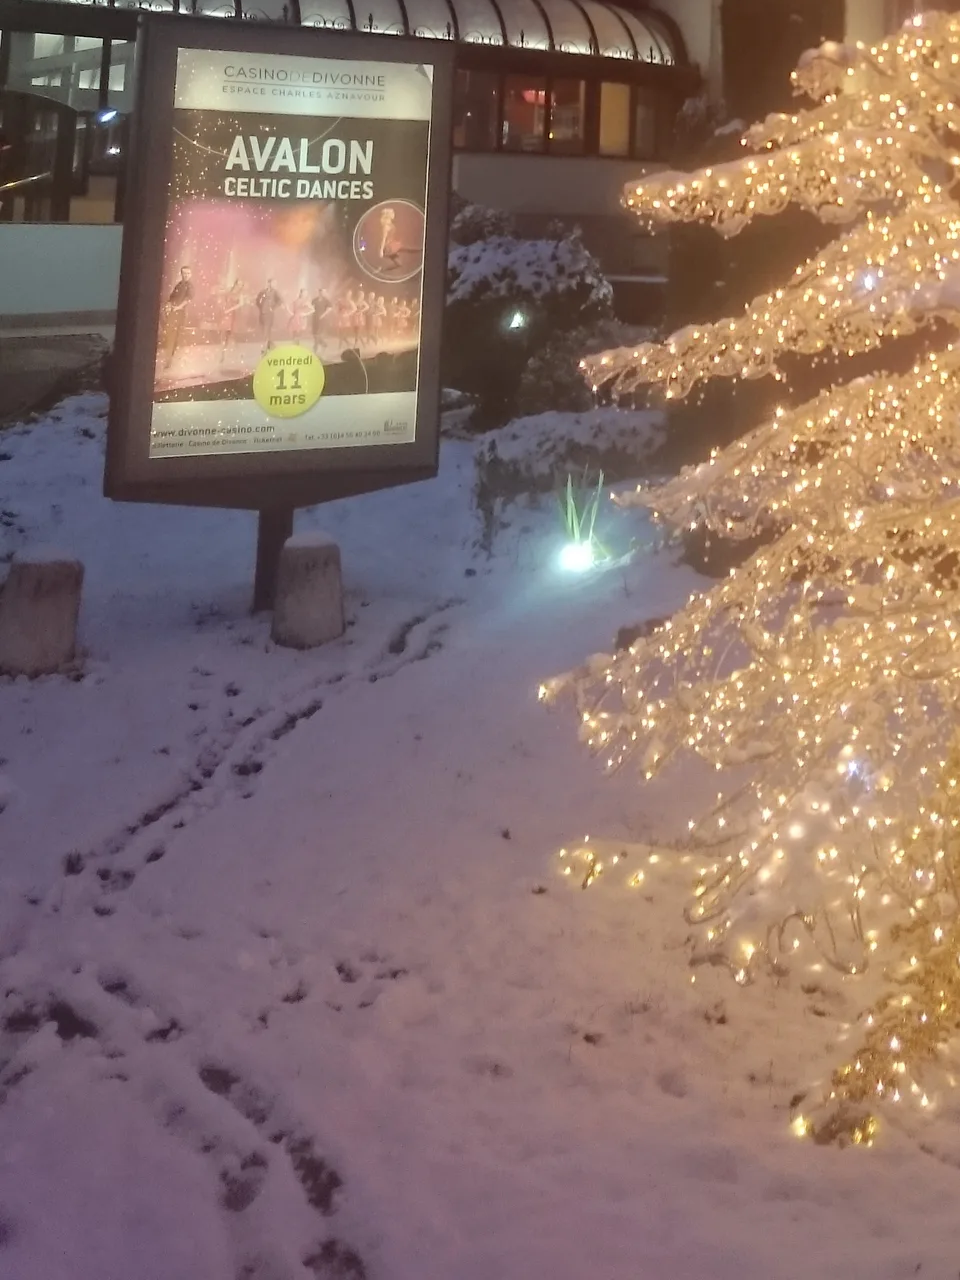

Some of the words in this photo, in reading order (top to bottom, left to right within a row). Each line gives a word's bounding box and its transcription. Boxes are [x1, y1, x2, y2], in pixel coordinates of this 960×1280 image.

[222, 85, 267, 96] ESPACE
[271, 88, 321, 98] CHARLES
[326, 91, 386, 102] AZNAVOUR
[225, 135, 374, 175] AVALON
[224, 177, 291, 198] CELTIC
[296, 179, 374, 199] DANCES
[267, 355, 313, 367] vendredi
[276, 369, 302, 390] 11
[269, 394, 306, 406] mars
[152, 425, 276, 438] www.divonne-casino.com
